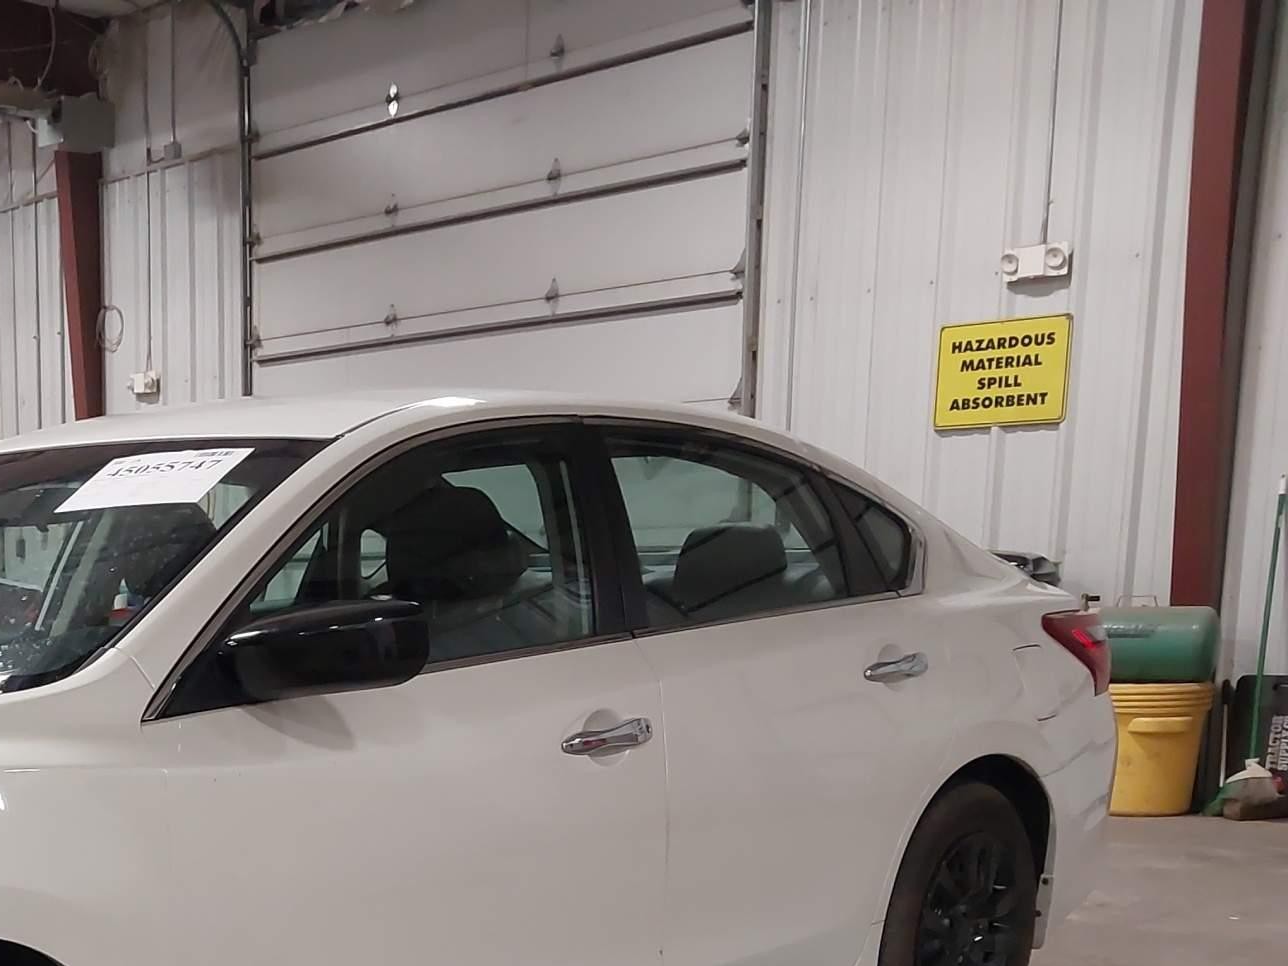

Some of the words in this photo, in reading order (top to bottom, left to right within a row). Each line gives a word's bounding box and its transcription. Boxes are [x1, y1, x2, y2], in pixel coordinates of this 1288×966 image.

[952, 332, 1056, 354] HAZARDOUS
[960, 353, 1042, 372] MATERIAL
[977, 375, 1022, 390] SPILL
[949, 392, 1048, 411] ABSORBENT
[106, 459, 223, 478] 45055747
[1265, 715, 1283, 769] TRACTOR
